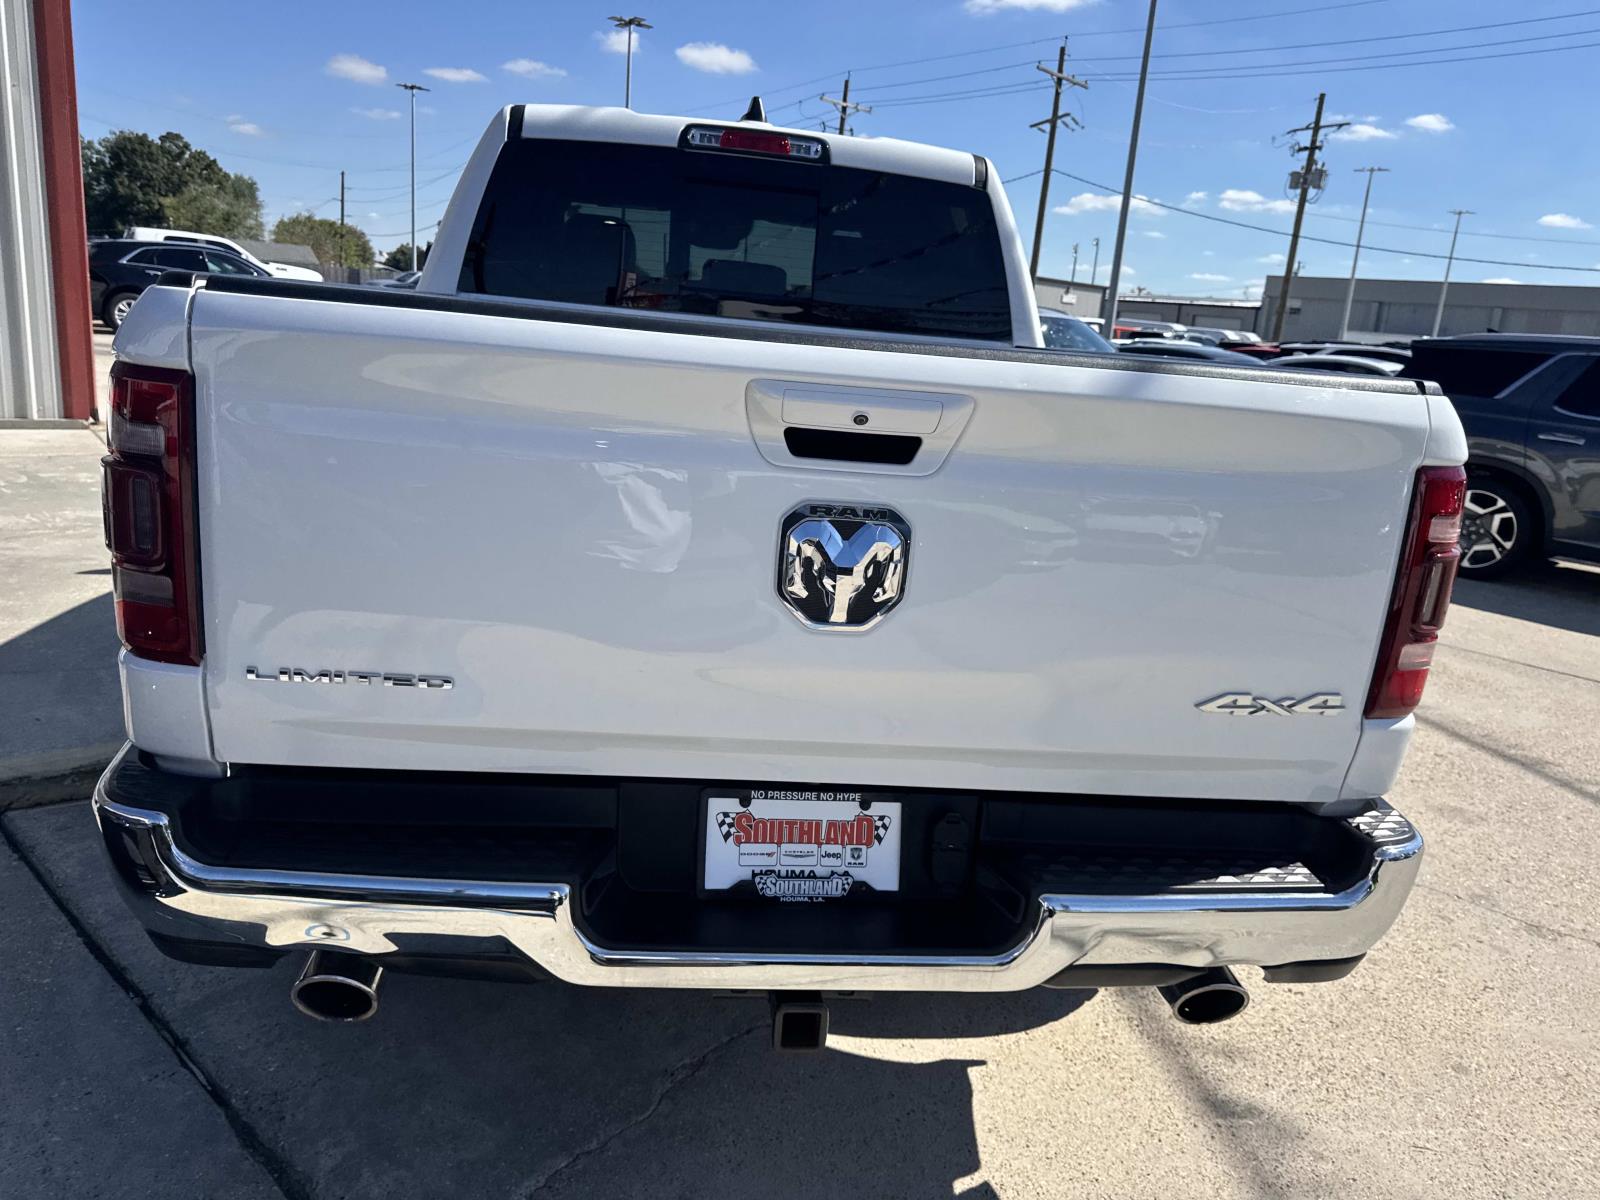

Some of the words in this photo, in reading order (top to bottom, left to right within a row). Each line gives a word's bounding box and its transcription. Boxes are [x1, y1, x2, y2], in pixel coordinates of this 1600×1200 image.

[809, 505, 889, 521] RAM
[246, 665, 455, 690] LIMITED
[751, 790, 765, 799] NO
[767, 791, 818, 801] PRESSURE
[820, 793, 834, 801] NO
[837, 793, 862, 802] HYPE
[733, 812, 876, 847] SOUTHLAND
[821, 850, 842, 860] Jeep
[765, 877, 843, 896] SOUTHLAND
